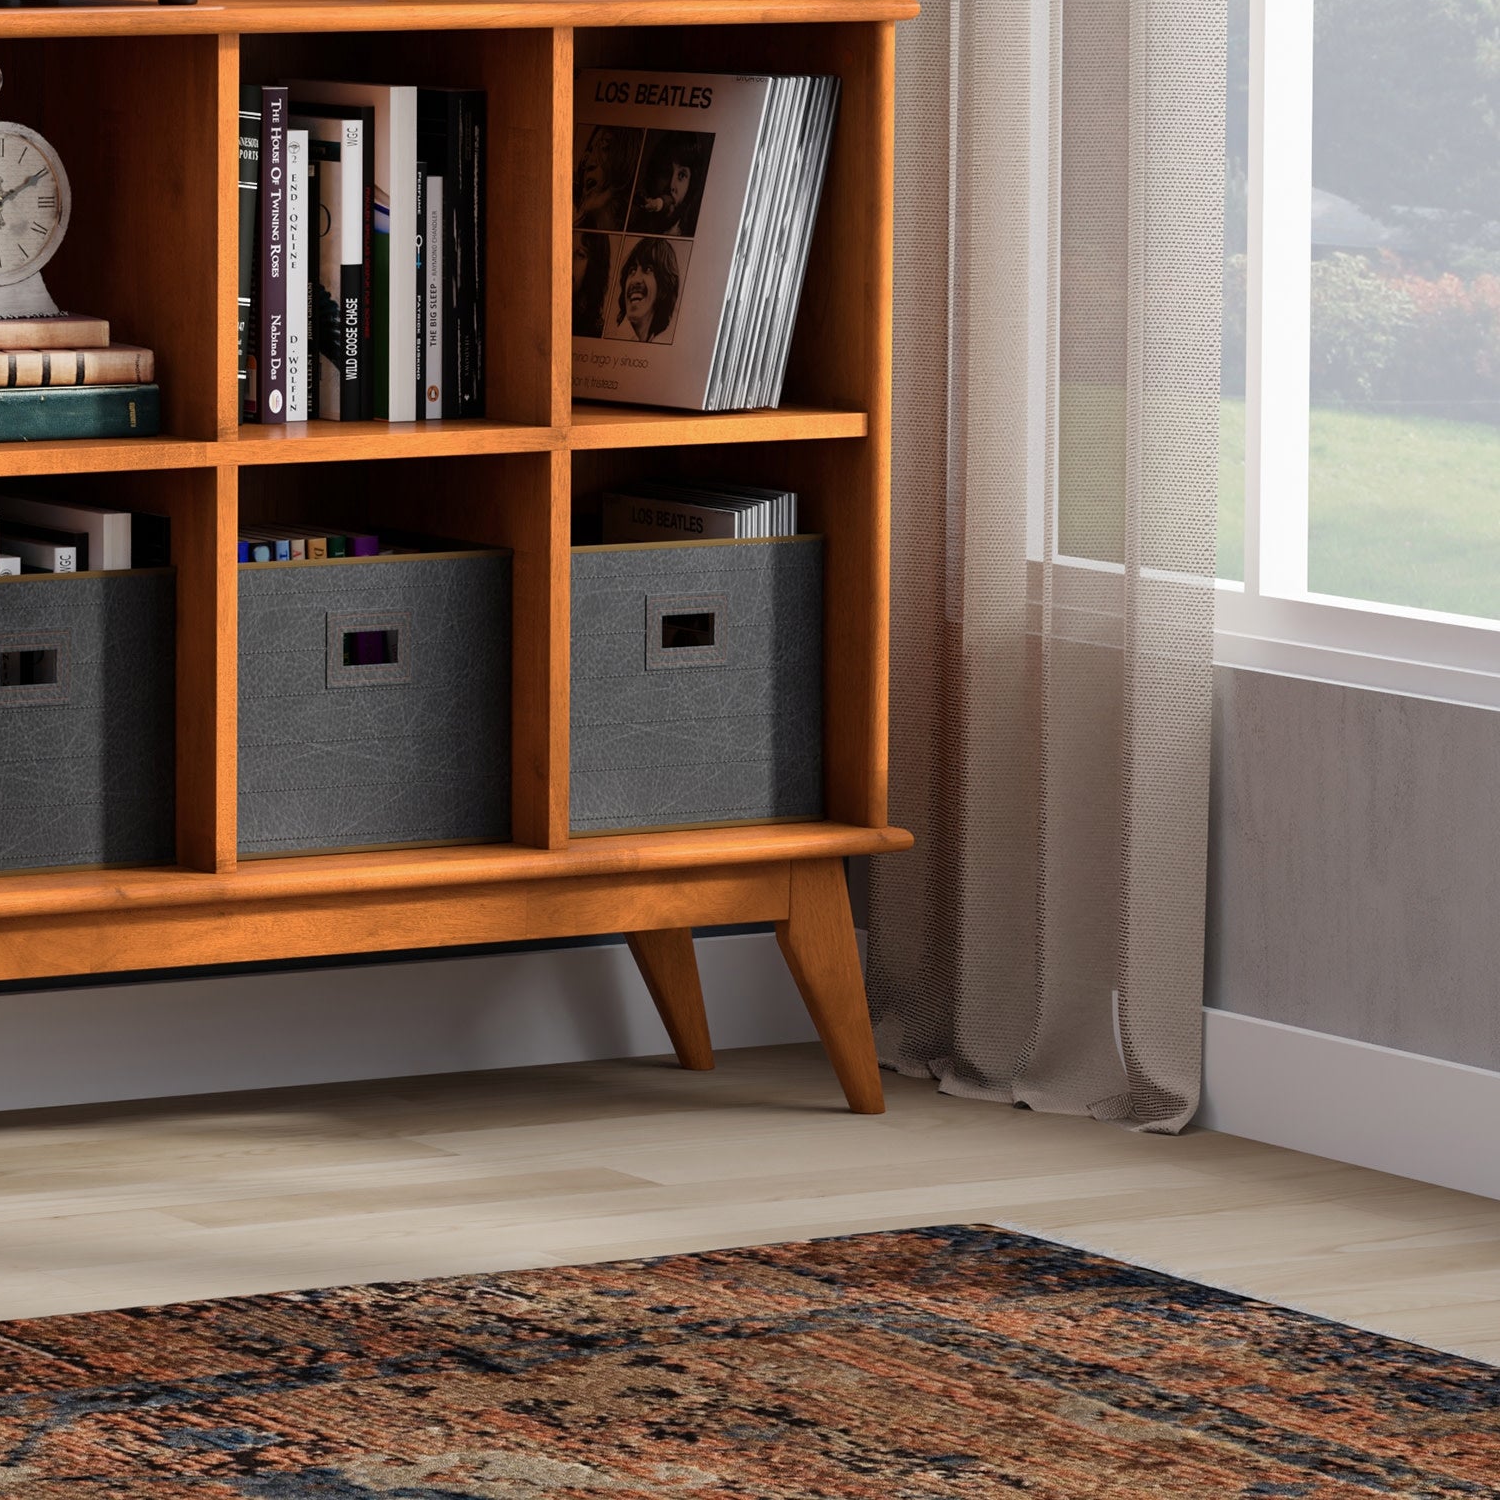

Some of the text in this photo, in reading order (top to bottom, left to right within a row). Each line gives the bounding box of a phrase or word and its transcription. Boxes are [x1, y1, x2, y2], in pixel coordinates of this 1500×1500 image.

[595, 80, 713, 109] LOS BEATLES
[347, 127, 358, 147] WGC
[271, 99, 282, 278] THE HOUSE OF TWINING ROSES
[271, 314, 282, 380] Nabina Das
[346, 298, 358, 381] WILD GOOSE CHASE
[631, 505, 704, 534] LOS BEATLES
